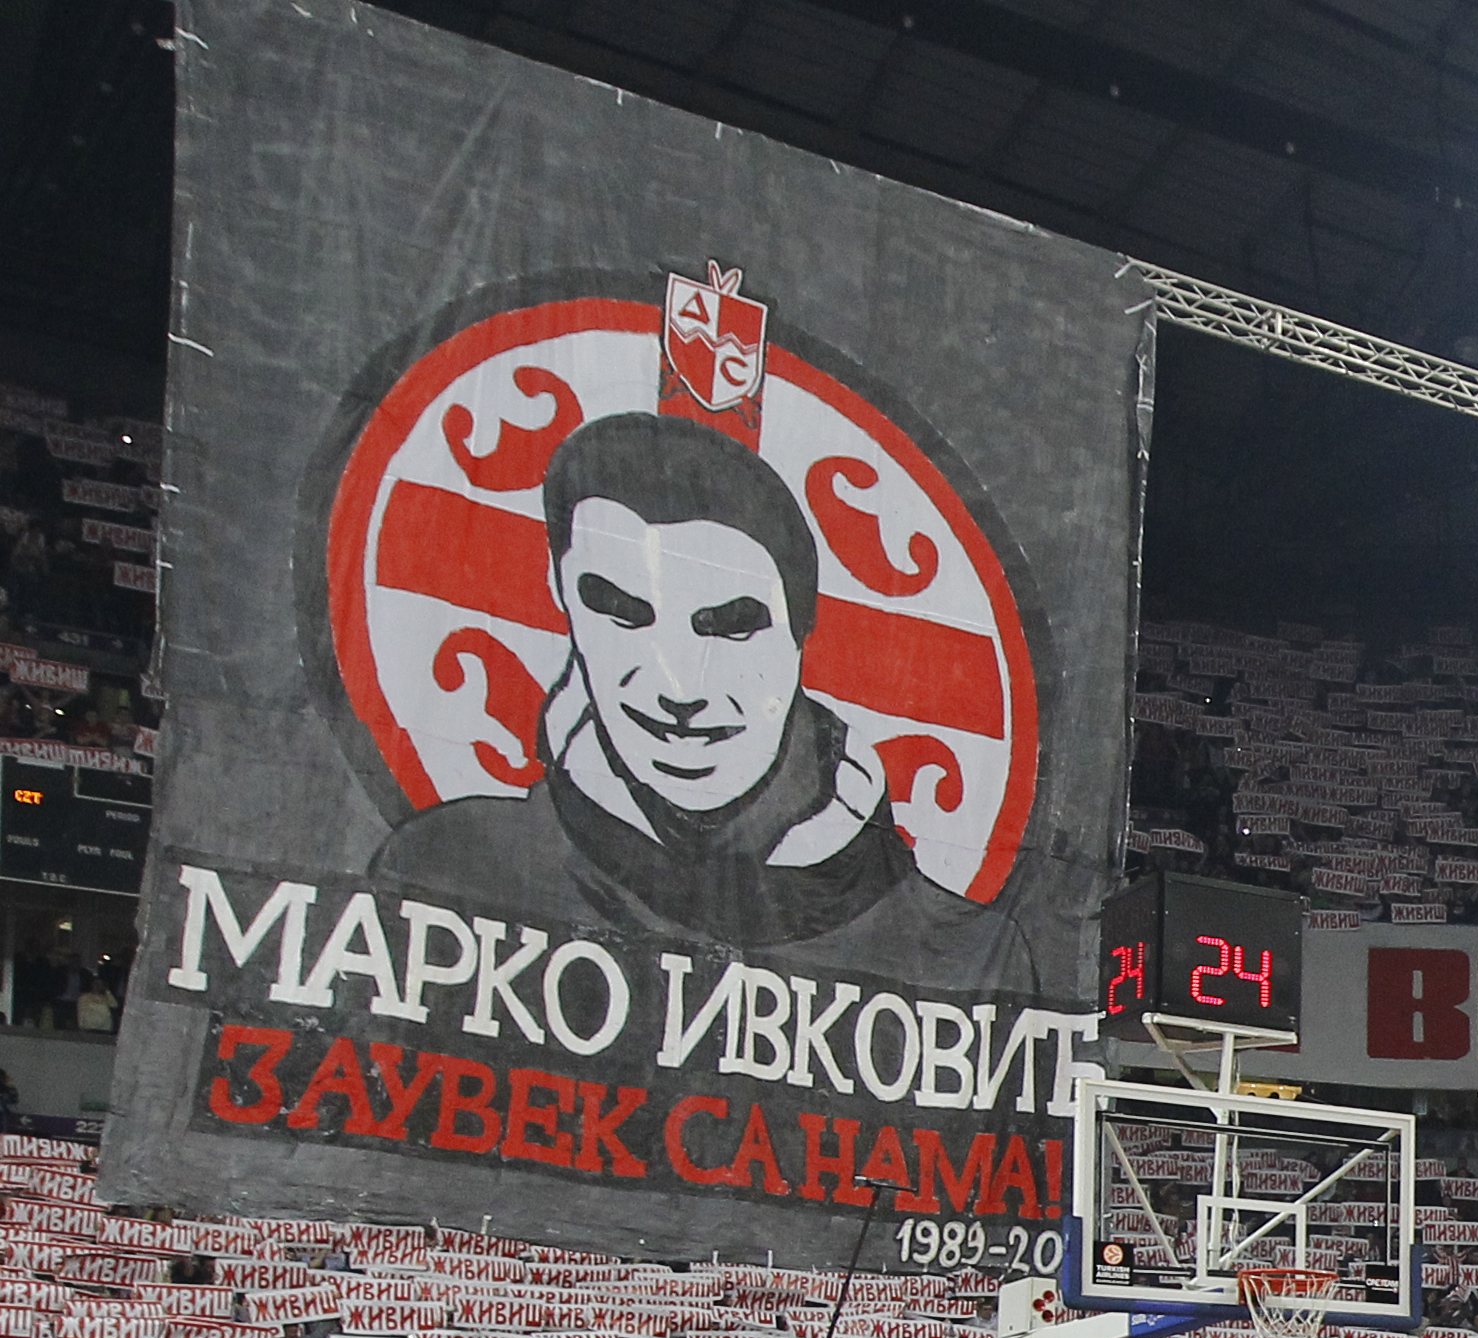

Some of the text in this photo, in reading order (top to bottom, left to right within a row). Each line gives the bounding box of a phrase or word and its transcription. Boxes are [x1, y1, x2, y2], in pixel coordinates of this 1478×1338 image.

[168, 864, 630, 1056] МАРКО
[1190, 935, 1273, 1008] 24
[1108, 940, 1145, 1015] 24
[208, 1024, 1062, 1220] ЗАУВЕК СА НАМА!
[105, 1221, 191, 1252] ЖИВИШ
[250, 1221, 330, 1244] ЖИВИШ
[896, 1218, 1062, 1275] 1989-20
[62, 1258, 157, 1285] ЖИВИШ
[219, 1264, 307, 1289] ЖИВИШ
[252, 1290, 338, 1320] ЖИВИШ
[345, 1306, 445, 1332] ЖИВИШ
